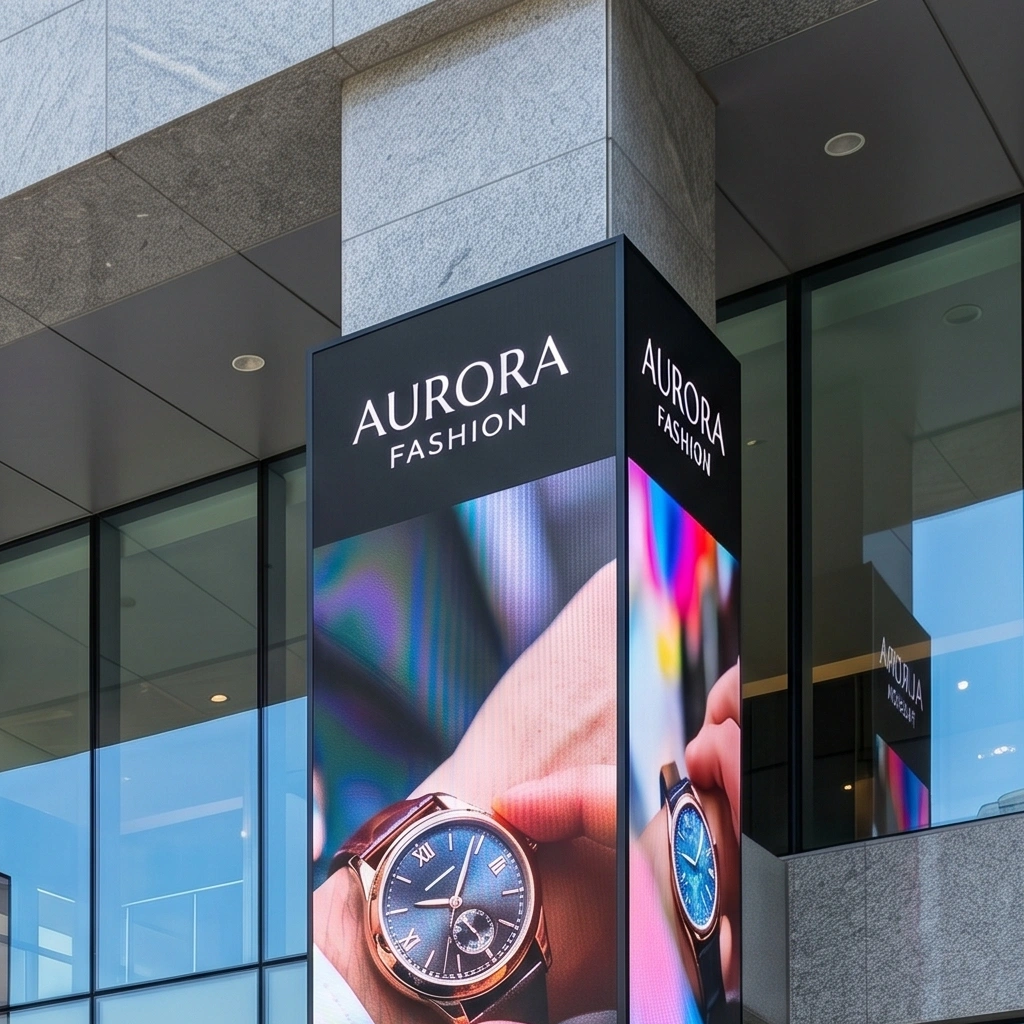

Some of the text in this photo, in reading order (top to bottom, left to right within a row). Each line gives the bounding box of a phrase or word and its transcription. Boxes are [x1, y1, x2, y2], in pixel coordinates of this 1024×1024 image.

[352, 335, 569, 445] AURORA
[641, 338, 726, 457] AURORA
[390, 404, 527, 469] FASHION
[657, 404, 711, 477] FASHION
